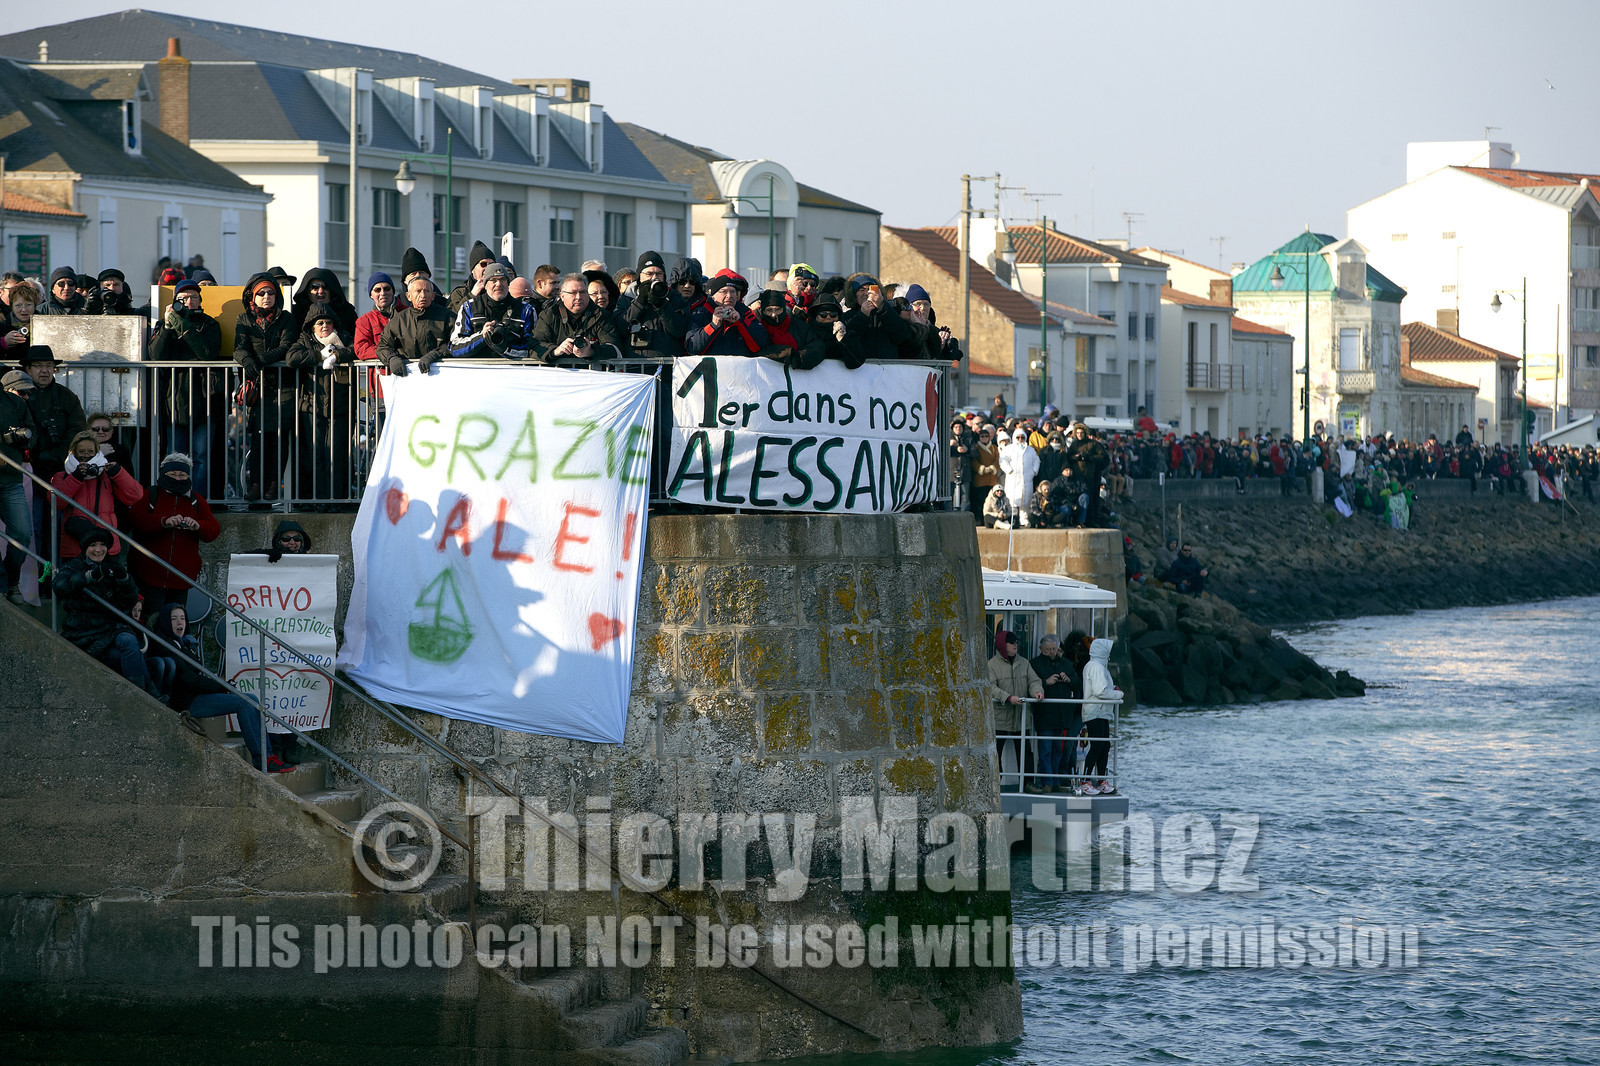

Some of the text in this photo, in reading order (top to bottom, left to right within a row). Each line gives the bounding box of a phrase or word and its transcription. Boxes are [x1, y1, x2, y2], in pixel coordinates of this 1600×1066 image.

[676, 357, 922, 432] 1er dans nos
[408, 409, 648, 485] GRAZIE
[227, 585, 311, 617] BRAVO
[984, 598, 1022, 606] D'EAU
[238, 646, 332, 668] ALSSANDRO
